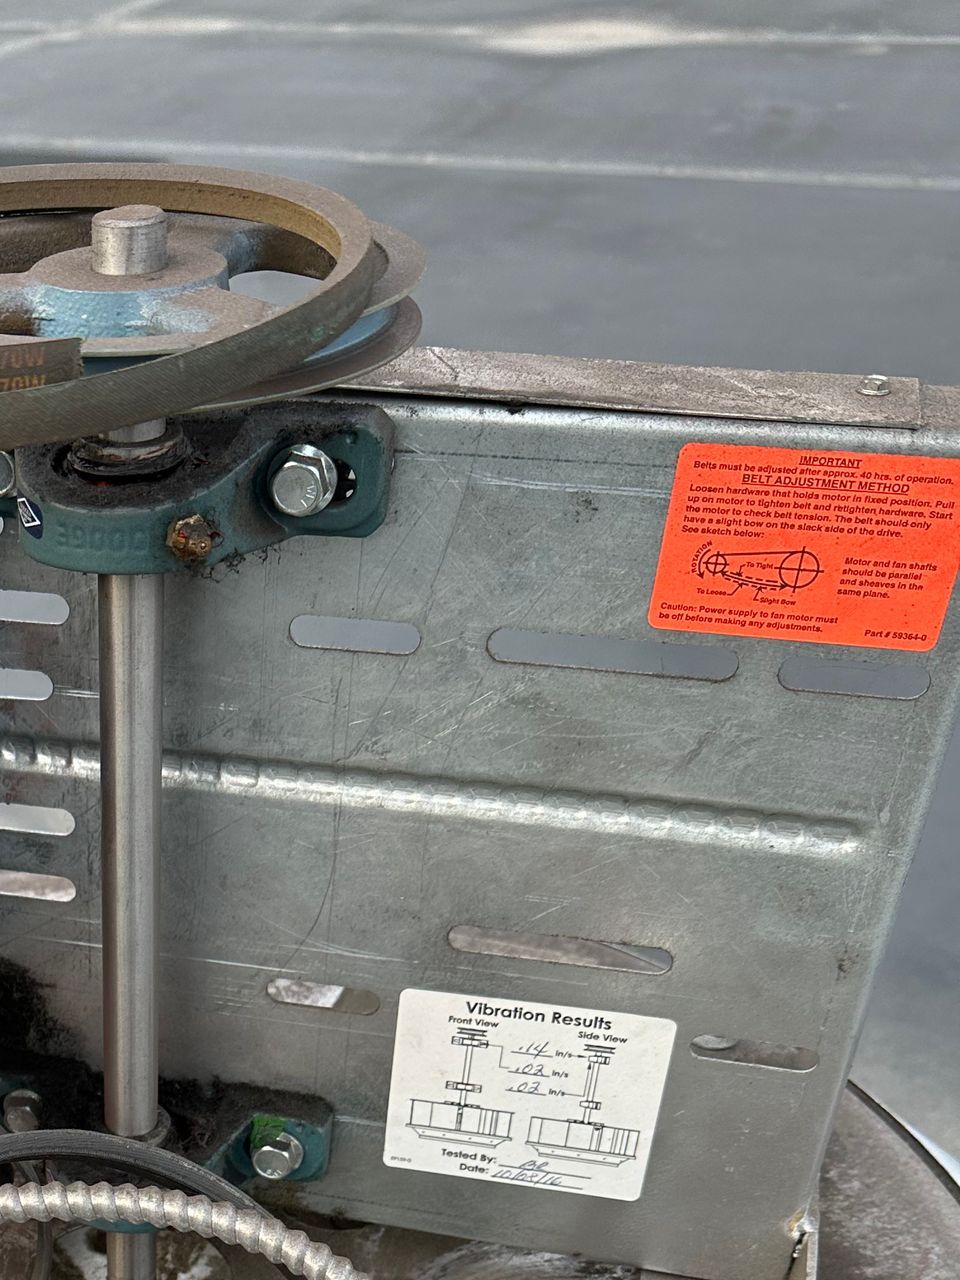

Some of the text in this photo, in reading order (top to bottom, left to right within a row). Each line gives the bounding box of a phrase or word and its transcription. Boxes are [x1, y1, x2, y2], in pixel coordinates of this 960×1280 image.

[798, 456, 862, 468] IMPORTANT
[693, 460, 717, 470] Belts
[718, 463, 742, 471] must
[743, 463, 756, 472] be
[757, 464, 798, 474] adjusted
[798, 467, 821, 476] after
[822, 469, 857, 478] approx.
[860, 470, 872, 480] 40
[894, 473, 905, 482] of
[906, 475, 954, 485] operation.
[742, 473, 910, 493] BELT ADJUSTMENT METHOD
[689, 484, 955, 509] Loosen hardware that holds motor in fixed position. Pull
[687, 495, 700, 504] up
[715, 497, 744, 505] motor
[746, 498, 756, 506] to
[757, 498, 790, 509] tighten
[792, 500, 811, 510] belt
[812, 503, 832, 511] and
[878, 507, 926, 518] hardware.
[928, 510, 953, 520] Start
[685, 504, 932, 530] the motor to check belt tension. The belt should only
[681, 524, 764, 538] See sketch below:
[683, 515, 706, 524] have
[715, 517, 742, 527] slight
[743, 519, 764, 527] bow
[780, 521, 795, 530] the
[797, 522, 823, 532] slack
[824, 524, 845, 533] side
[846, 526, 858, 534] of
[859, 526, 874, 535] the
[876, 528, 903, 538] drive.
[691, 540, 713, 574] ROTATION
[844, 556, 937, 571] Motor and fan shafts
[745, 560, 773, 570] To Tight
[842, 567, 922, 580] should be parallel
[839, 578, 923, 590] and sheaves in the
[705, 588, 727, 596] Loose
[836, 588, 890, 598] same plane.
[780, 598, 796, 606] Bow
[660, 601, 838, 624] Caution: Power supply to fan motor must
[658, 611, 823, 632] be off before making any adjustments.
[864, 628, 883, 638] Part
[884, 630, 891, 638] #
[448, 1015, 499, 1027] Front View
[466, 1001, 612, 1030] Vibration Results
[577, 1031, 628, 1043] Side View
[442, 1148, 477, 1160] Tested
[479, 1154, 496, 1164] By:
[459, 1163, 489, 1173] Date:
